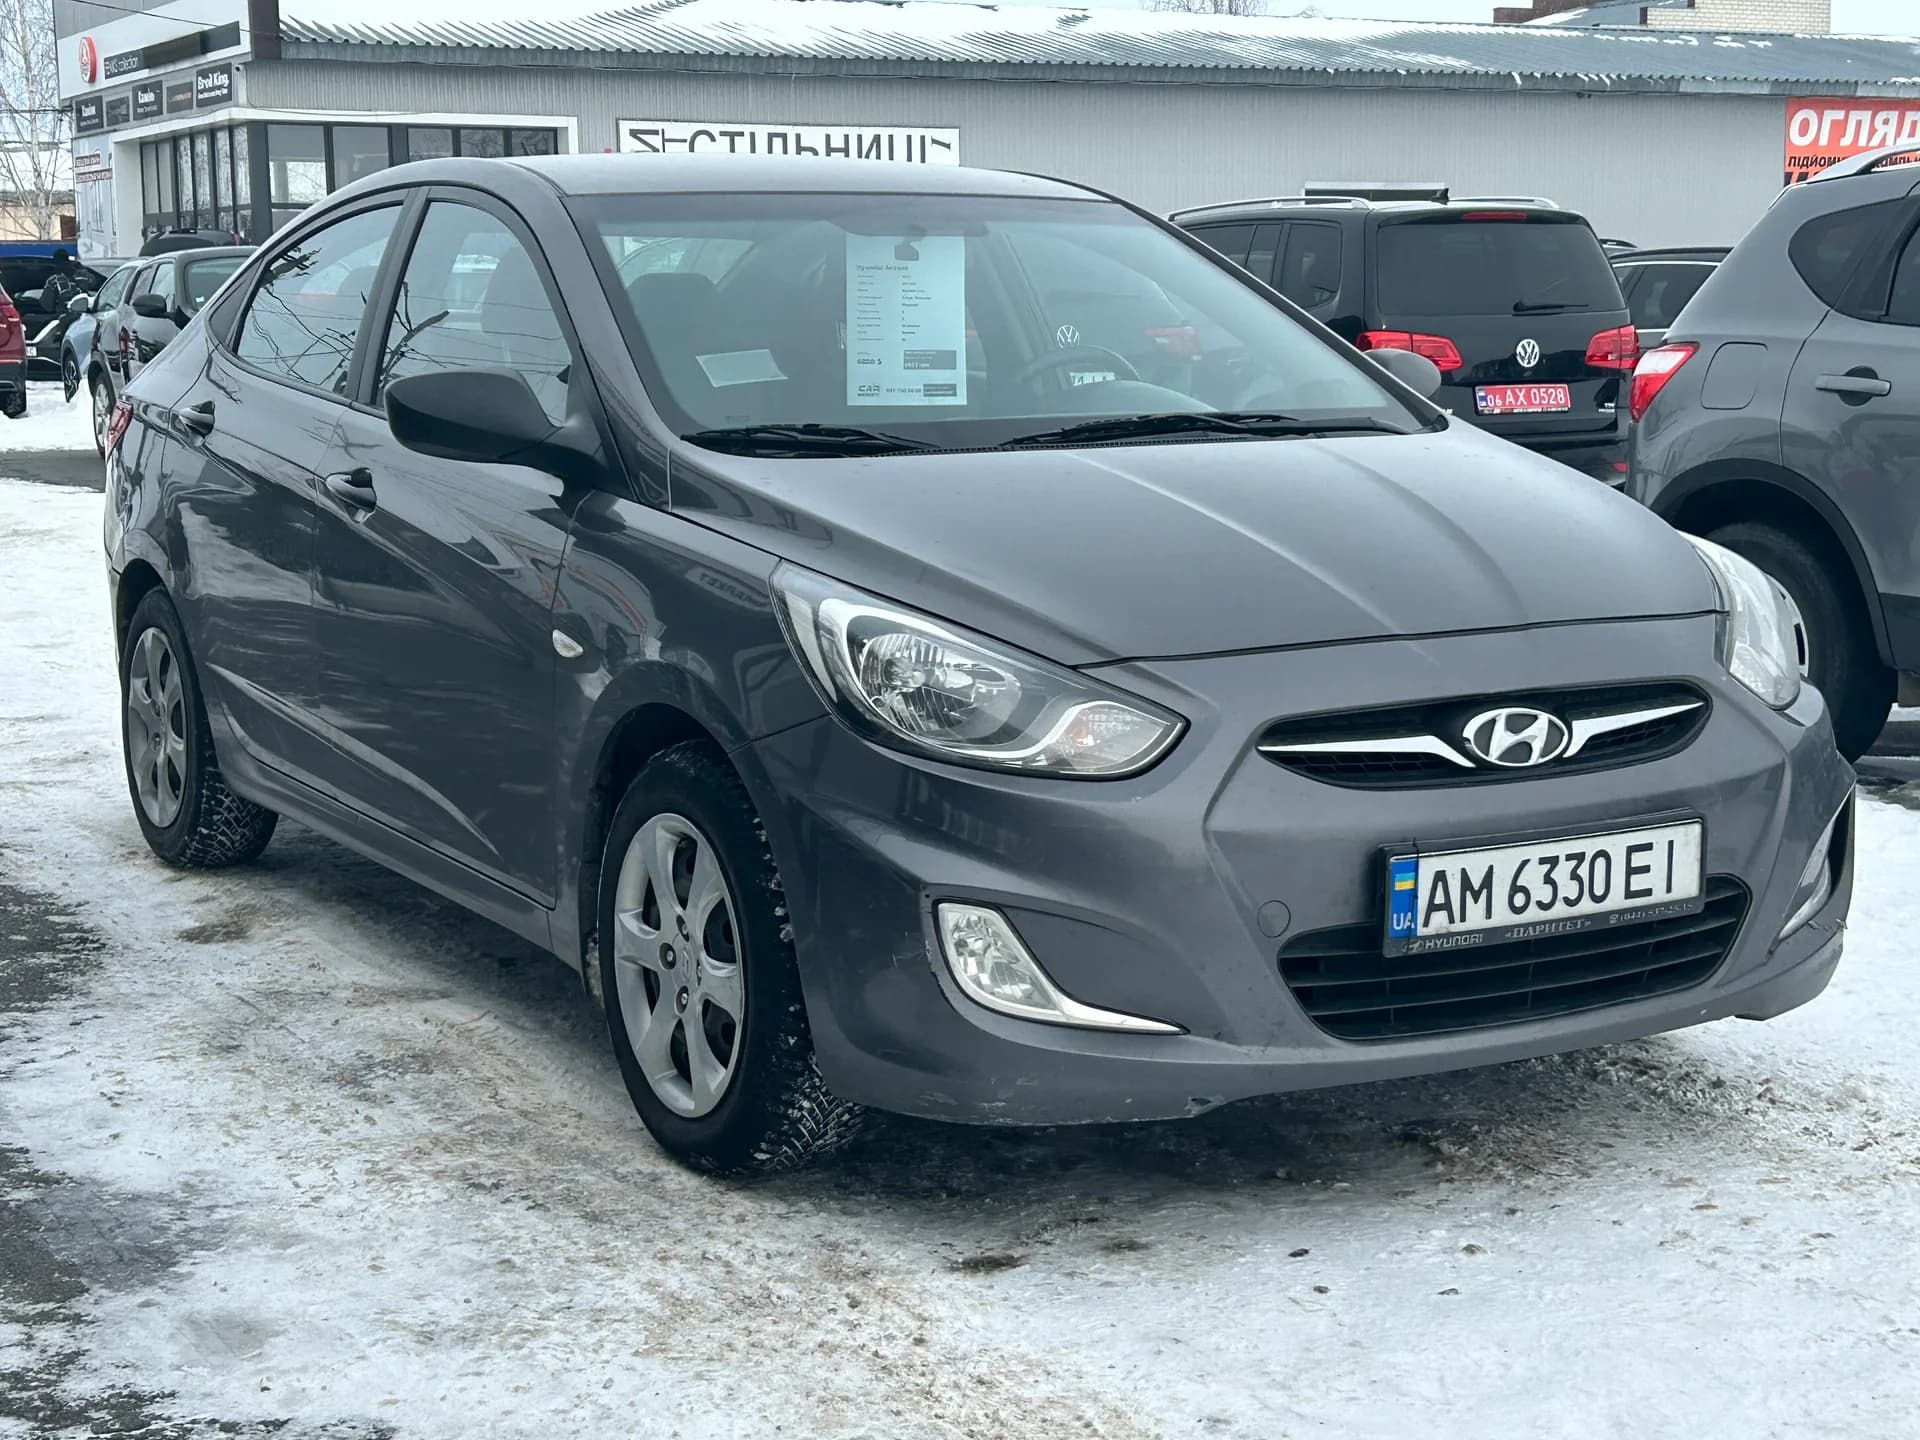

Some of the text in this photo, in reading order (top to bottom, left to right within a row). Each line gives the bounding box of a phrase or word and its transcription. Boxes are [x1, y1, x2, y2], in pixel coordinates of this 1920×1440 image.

[1487, 388, 1566, 407] 06 AX 0528
[1421, 839, 1676, 929] AM 6330 EI
[1391, 911, 1416, 931] UA
[1425, 933, 1483, 950] HYUNDAI
